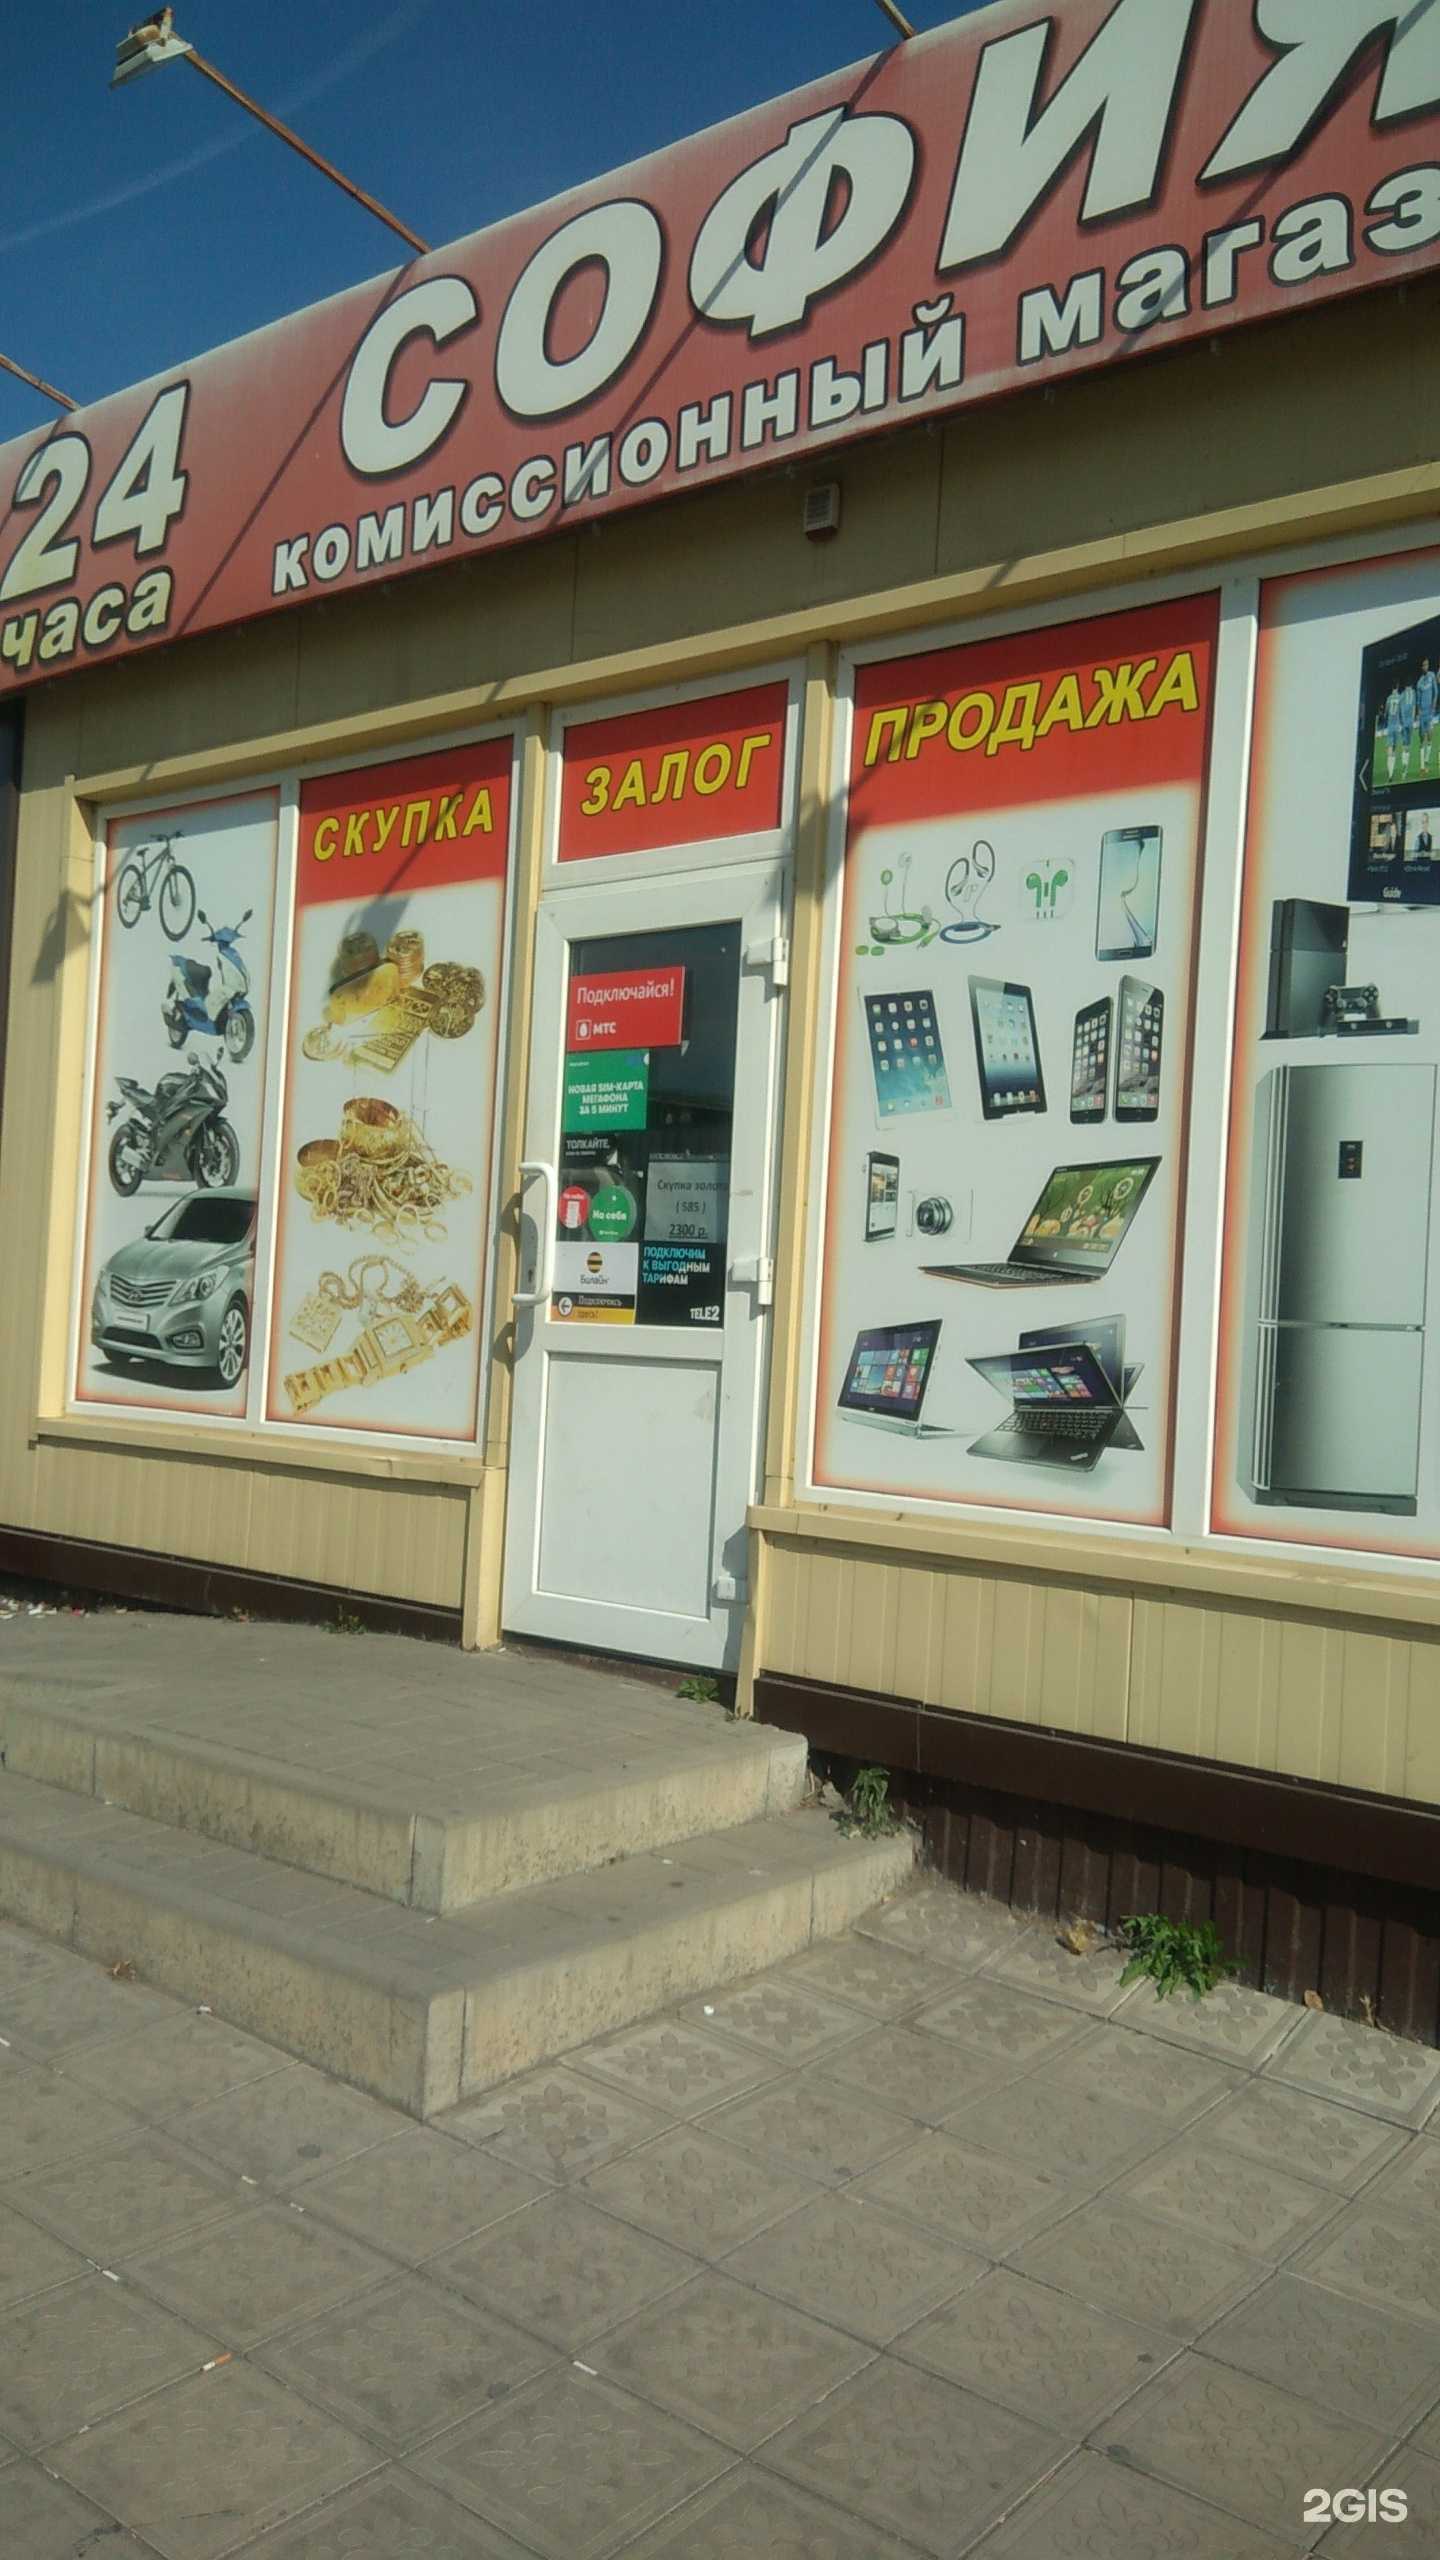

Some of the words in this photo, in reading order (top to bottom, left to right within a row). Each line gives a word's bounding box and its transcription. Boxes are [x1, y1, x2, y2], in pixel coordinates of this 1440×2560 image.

[340, 0, 1440, 478] СОФИЯ
[271, 295, 966, 596] комиссионный
[0, 379, 190, 602] 24
[1, 565, 174, 671] часа
[863, 651, 1200, 767] ПРОДАЖА
[580, 732, 773, 816] ЗАЛОГ
[313, 788, 495, 862] СКУПКА
[577, 977, 675, 1006] Подключайся!
[592, 1022, 617, 1035] МТС
[642, 1272, 689, 1285] ТАРИФАМ
[643, 1246, 706, 1259] ПОДКЛЮЧИМ
[651, 1260, 710, 1273] ВЫГОДНЫМ
[690, 1305, 720, 1321] TELE2
